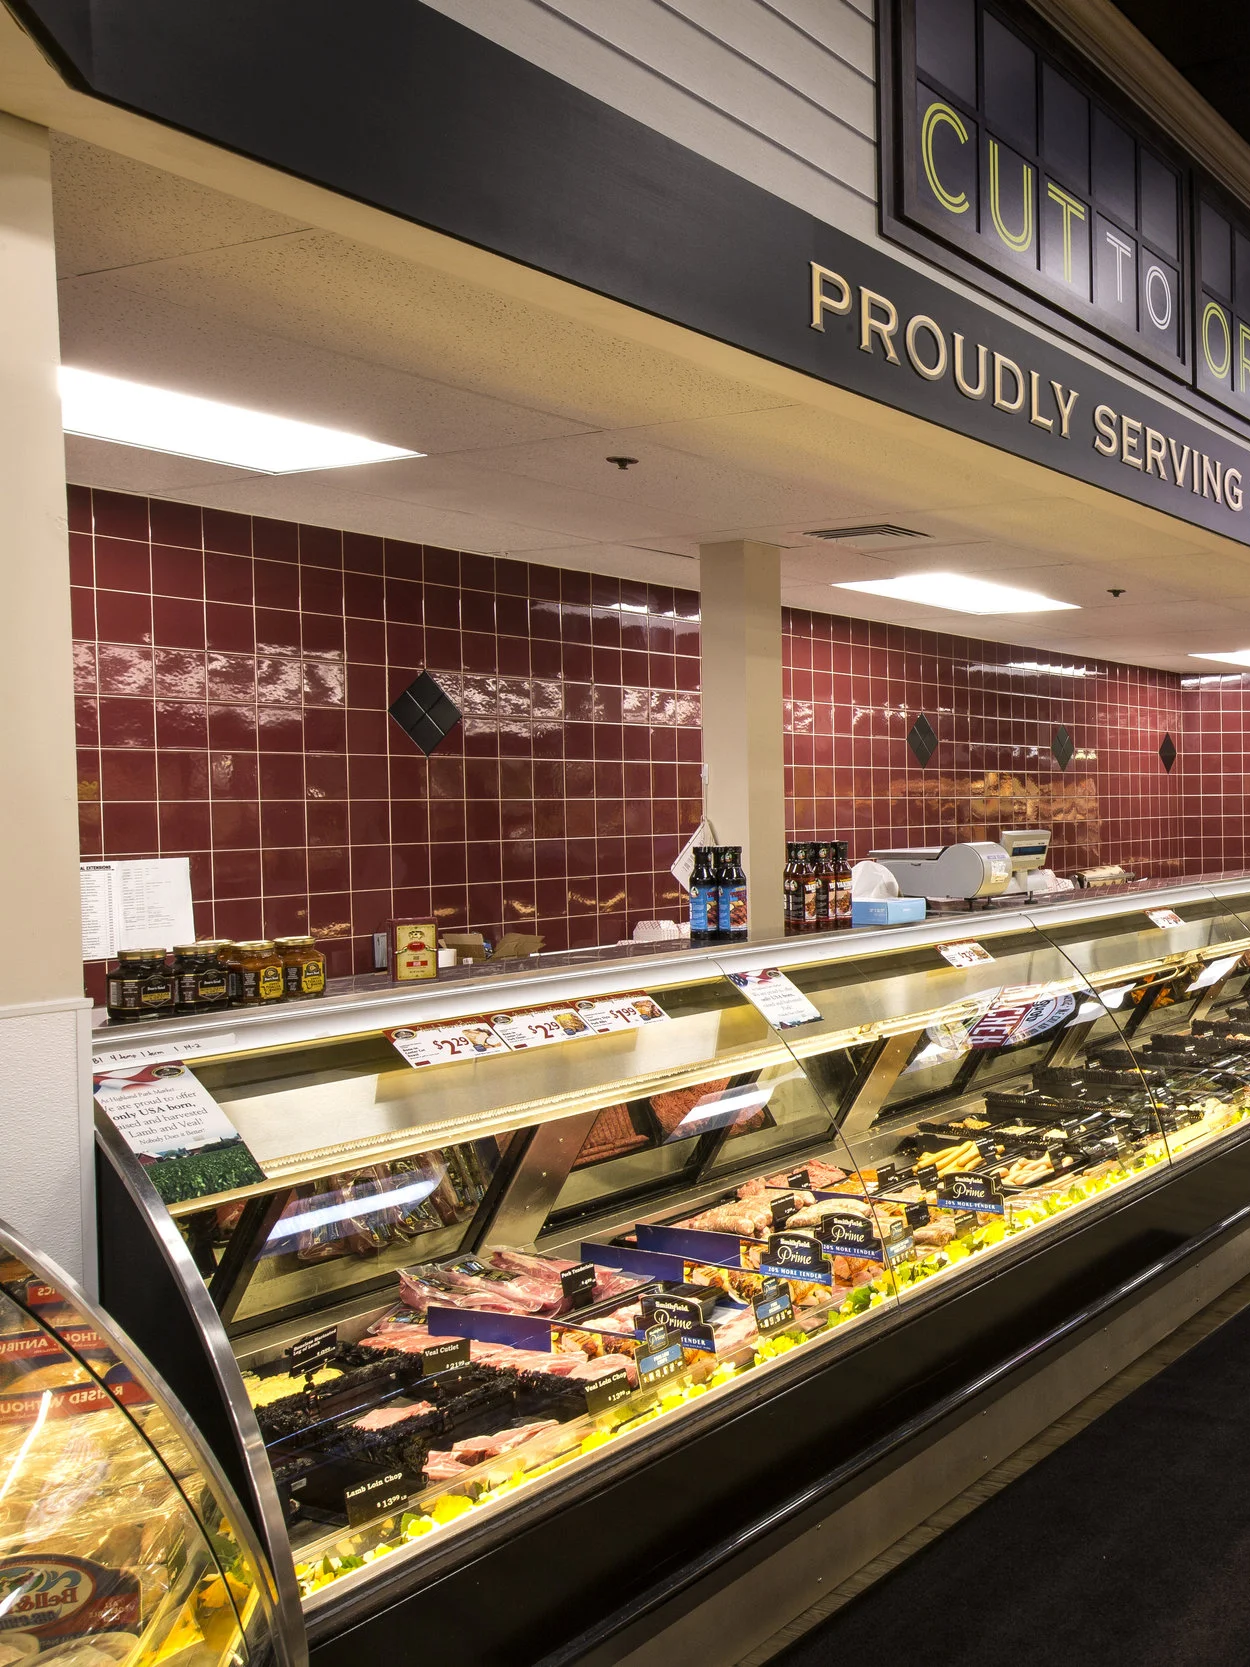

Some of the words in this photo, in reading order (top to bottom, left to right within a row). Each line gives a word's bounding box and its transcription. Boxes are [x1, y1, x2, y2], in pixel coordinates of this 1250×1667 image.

[921, 102, 1085, 283] CUT
[1106, 232, 1172, 330] TO
[810, 260, 1080, 440] PROUDLY
[1093, 403, 1244, 512] SERVING
[109, 1092, 137, 1104] Highland
[138, 1090, 152, 1099] Park
[133, 1098, 161, 1110] proud
[175, 1091, 198, 1101] offer
[113, 1112, 137, 1124] only
[139, 1106, 166, 1117] USA
[168, 1101, 196, 1112] born,
[118, 1120, 141, 1131] aised
[143, 1116, 161, 1126] and
[164, 1107, 208, 1122] harvested
[128, 1127, 158, 1138] Lamb
[159, 1124, 177, 1134] and
[177, 1117, 204, 1129] Veal!
[139, 1136, 164, 1145] Nobody
[164, 1133, 179, 1141] Does
[955, 1176, 983, 1185] Smithfield
[952, 1182, 985, 1199] Prime
[833, 1217, 863, 1228] Smithfield
[831, 1224, 865, 1243] Prime
[780, 1238, 811, 1249] Smithfield
[776, 1245, 812, 1265] Prime
[799, 1271, 822, 1279] TENDER
[655, 1301, 690, 1313] Smithfield
[653, 1309, 693, 1330] Prime
[424, 1347, 439, 1358] Veal
[440, 1343, 460, 1354] Cutlet
[585, 1382, 599, 1393] Veal
[598, 1378, 612, 1388] Loin
[612, 1371, 627, 1382] Chop
[346, 1485, 367, 1499] Lamb
[367, 1480, 384, 1490] Loin
[384, 1472, 403, 1483] Chop
